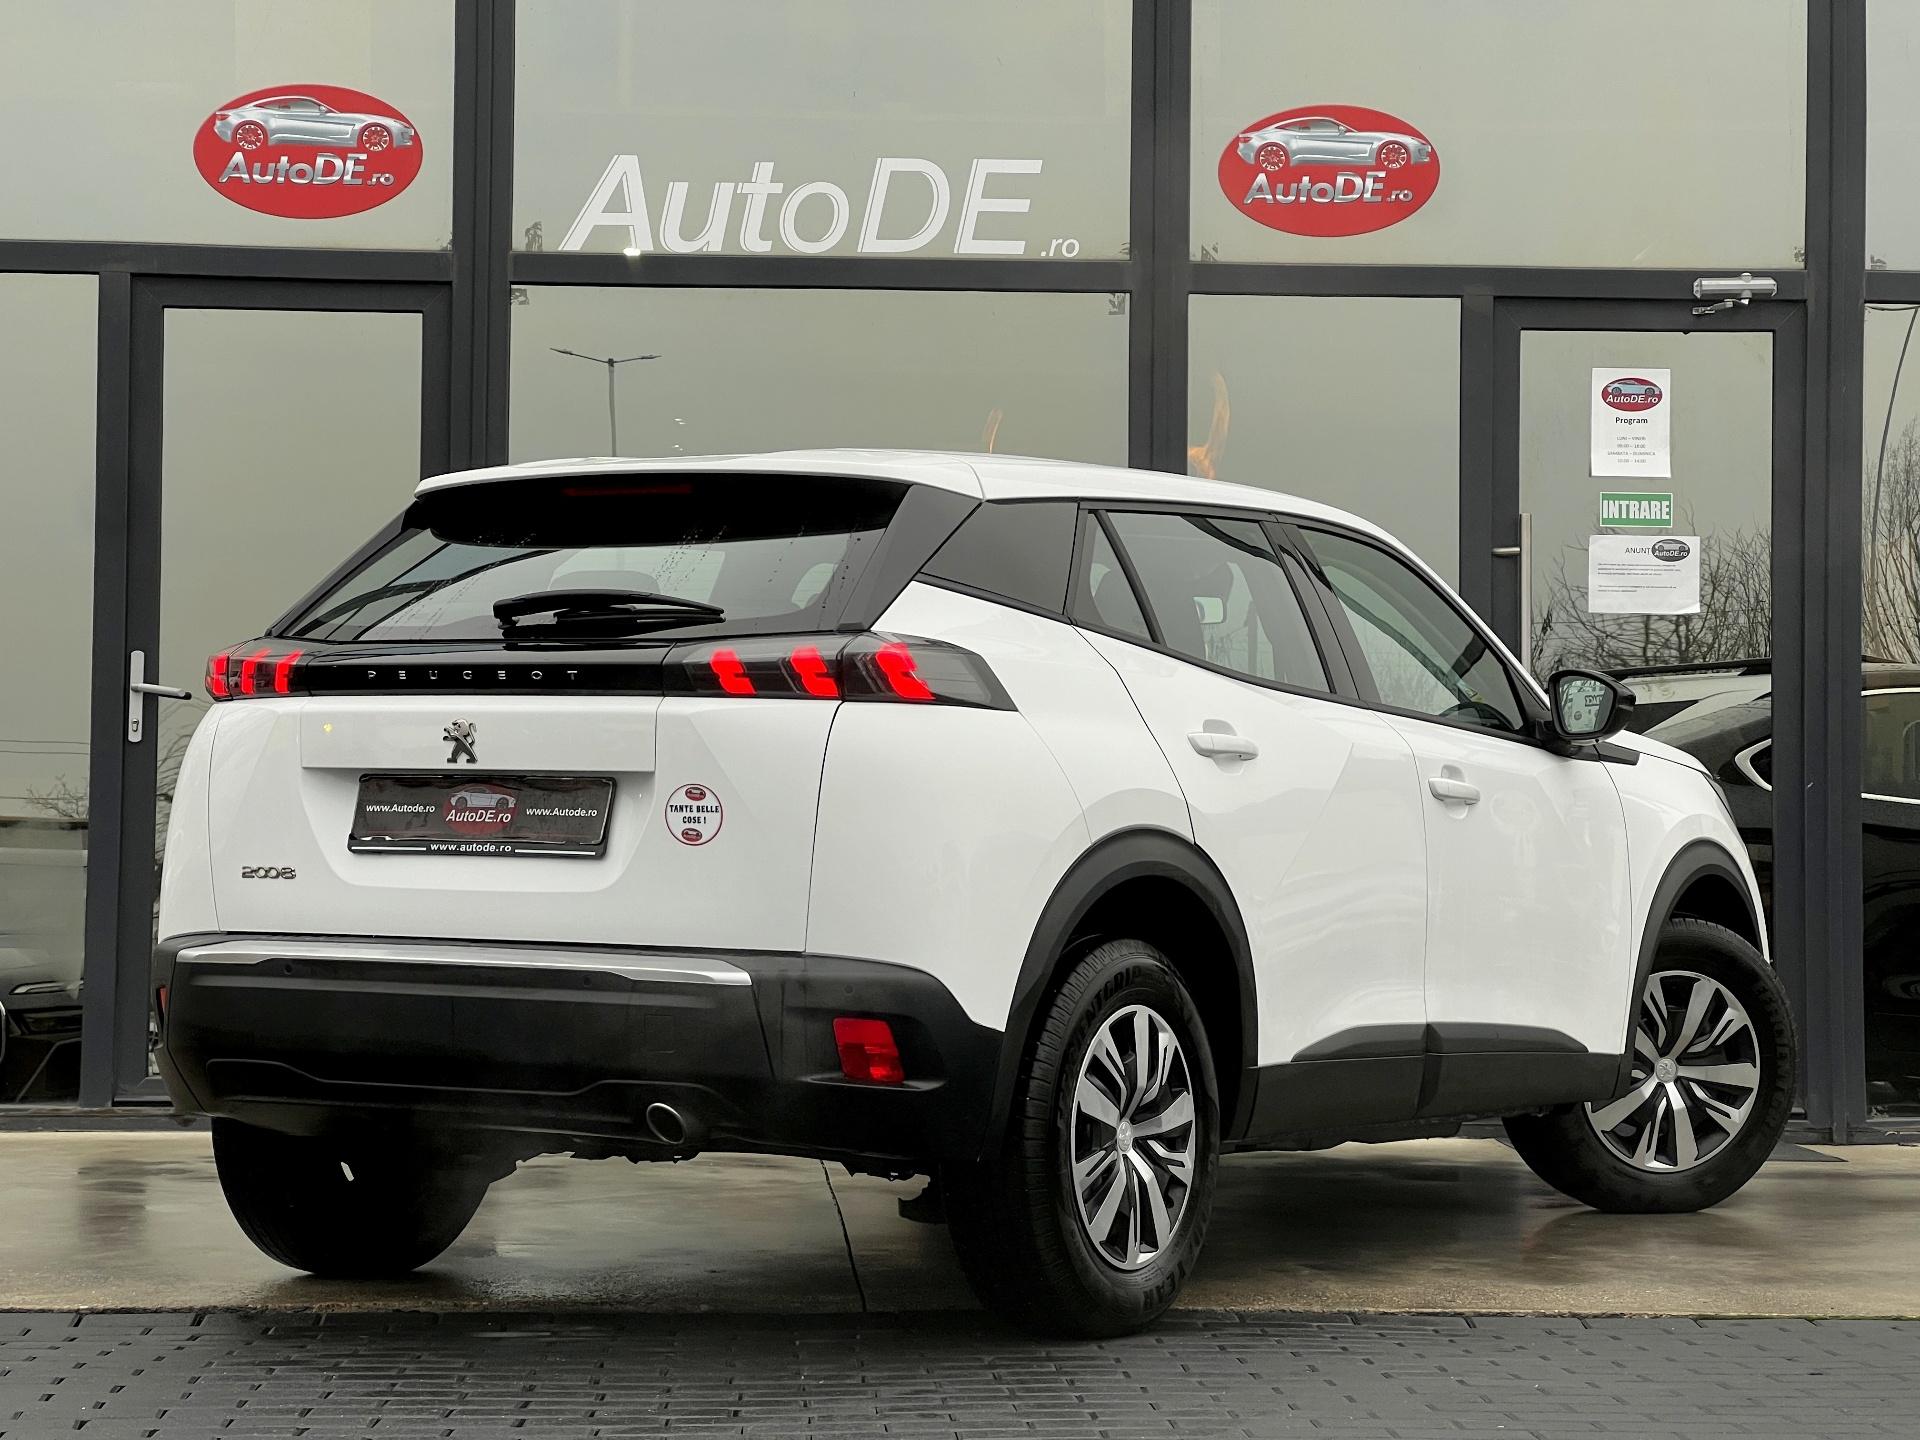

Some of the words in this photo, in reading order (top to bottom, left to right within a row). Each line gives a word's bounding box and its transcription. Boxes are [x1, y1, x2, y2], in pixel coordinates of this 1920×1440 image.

[1606, 394, 1659, 404] AutoDE.ro
[1615, 416, 1648, 425] Program
[1602, 499, 1670, 520] INTRARE
[367, 670, 578, 681] PEUGEOT
[365, 803, 436, 813] www.Autode.ro
[526, 807, 598, 817] www.Autode.ro
[669, 804, 694, 813] TANTE
[696, 805, 720, 813] BELLE
[446, 809, 512, 823] AutoDE.ro
[430, 842, 512, 853] www.autode.ro
[241, 866, 297, 880] 2008
